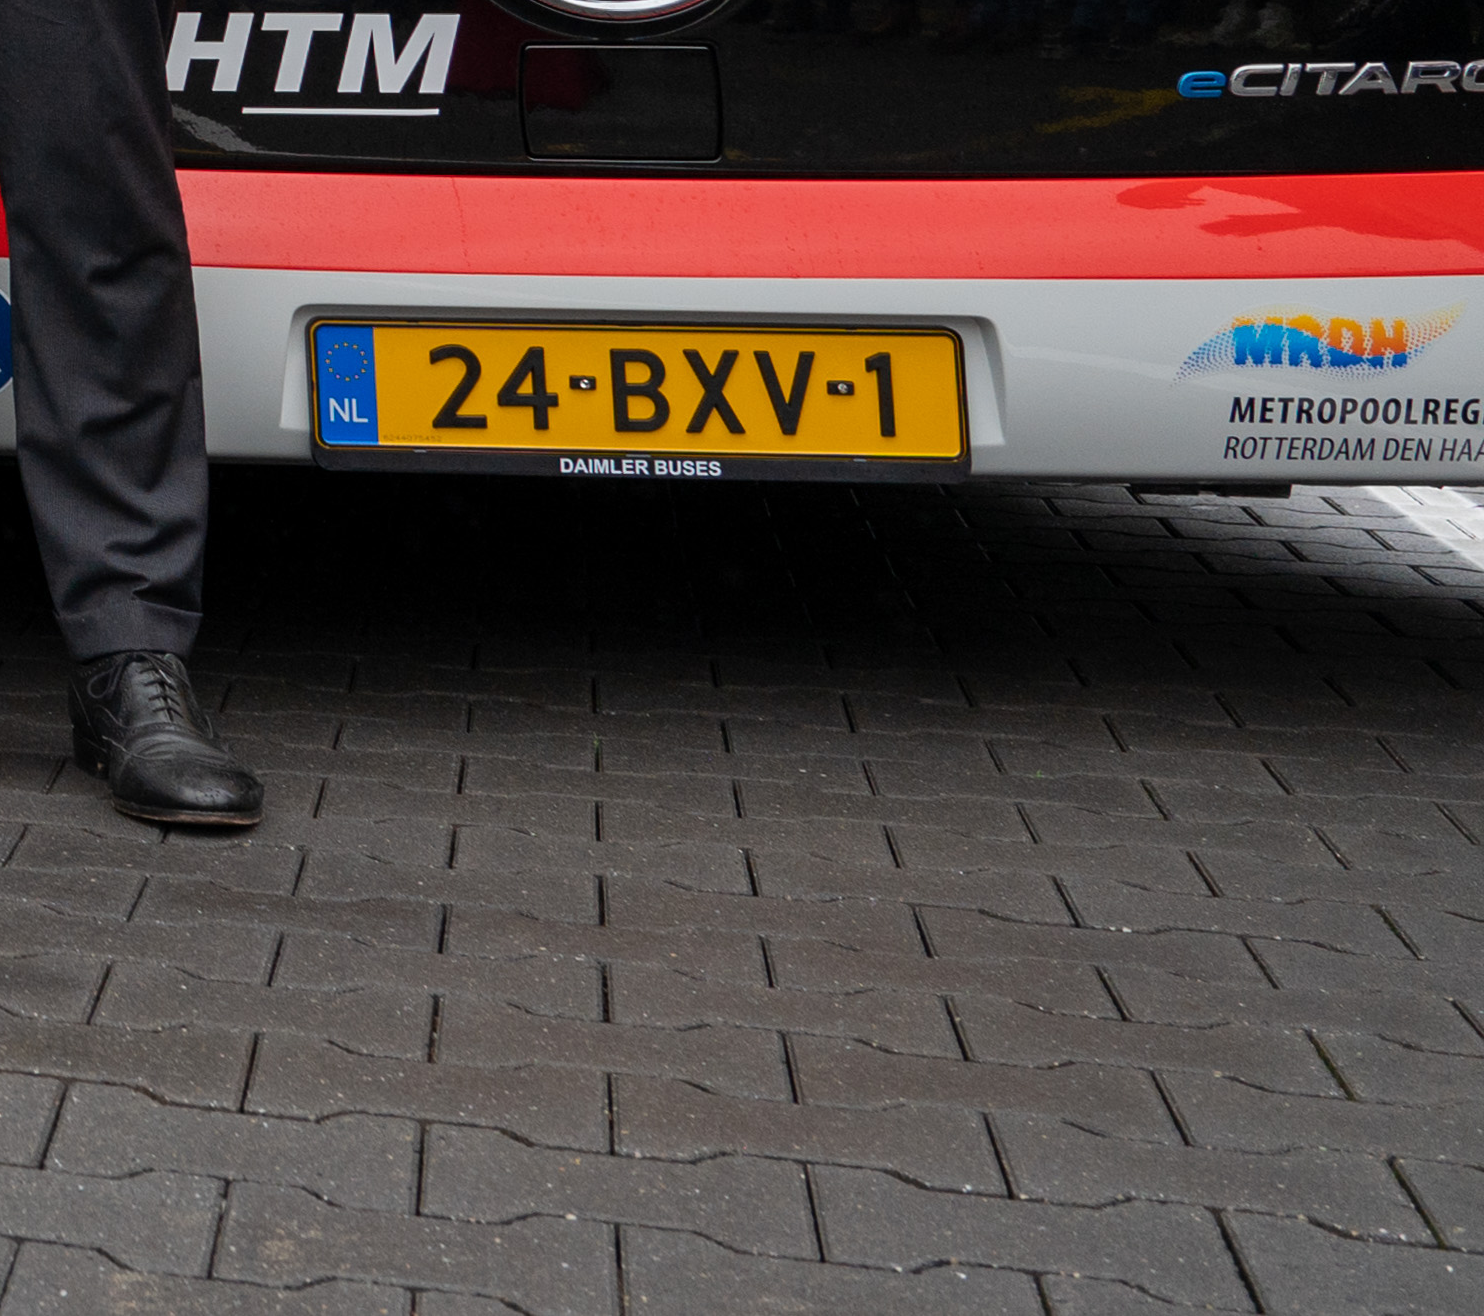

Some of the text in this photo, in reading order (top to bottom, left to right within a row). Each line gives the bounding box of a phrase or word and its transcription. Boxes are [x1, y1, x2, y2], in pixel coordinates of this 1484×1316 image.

[165, 11, 462, 95] HTM
[1232, 313, 1409, 368] MRDH
[429, 343, 898, 439] 24-BXV-1
[328, 397, 369, 423] NL
[1228, 397, 1484, 425] METROPOOLREG
[1223, 437, 1376, 462] ROTTERDAM
[1382, 437, 1433, 462] DEN
[559, 457, 722, 477] DAIMLER BUSES
